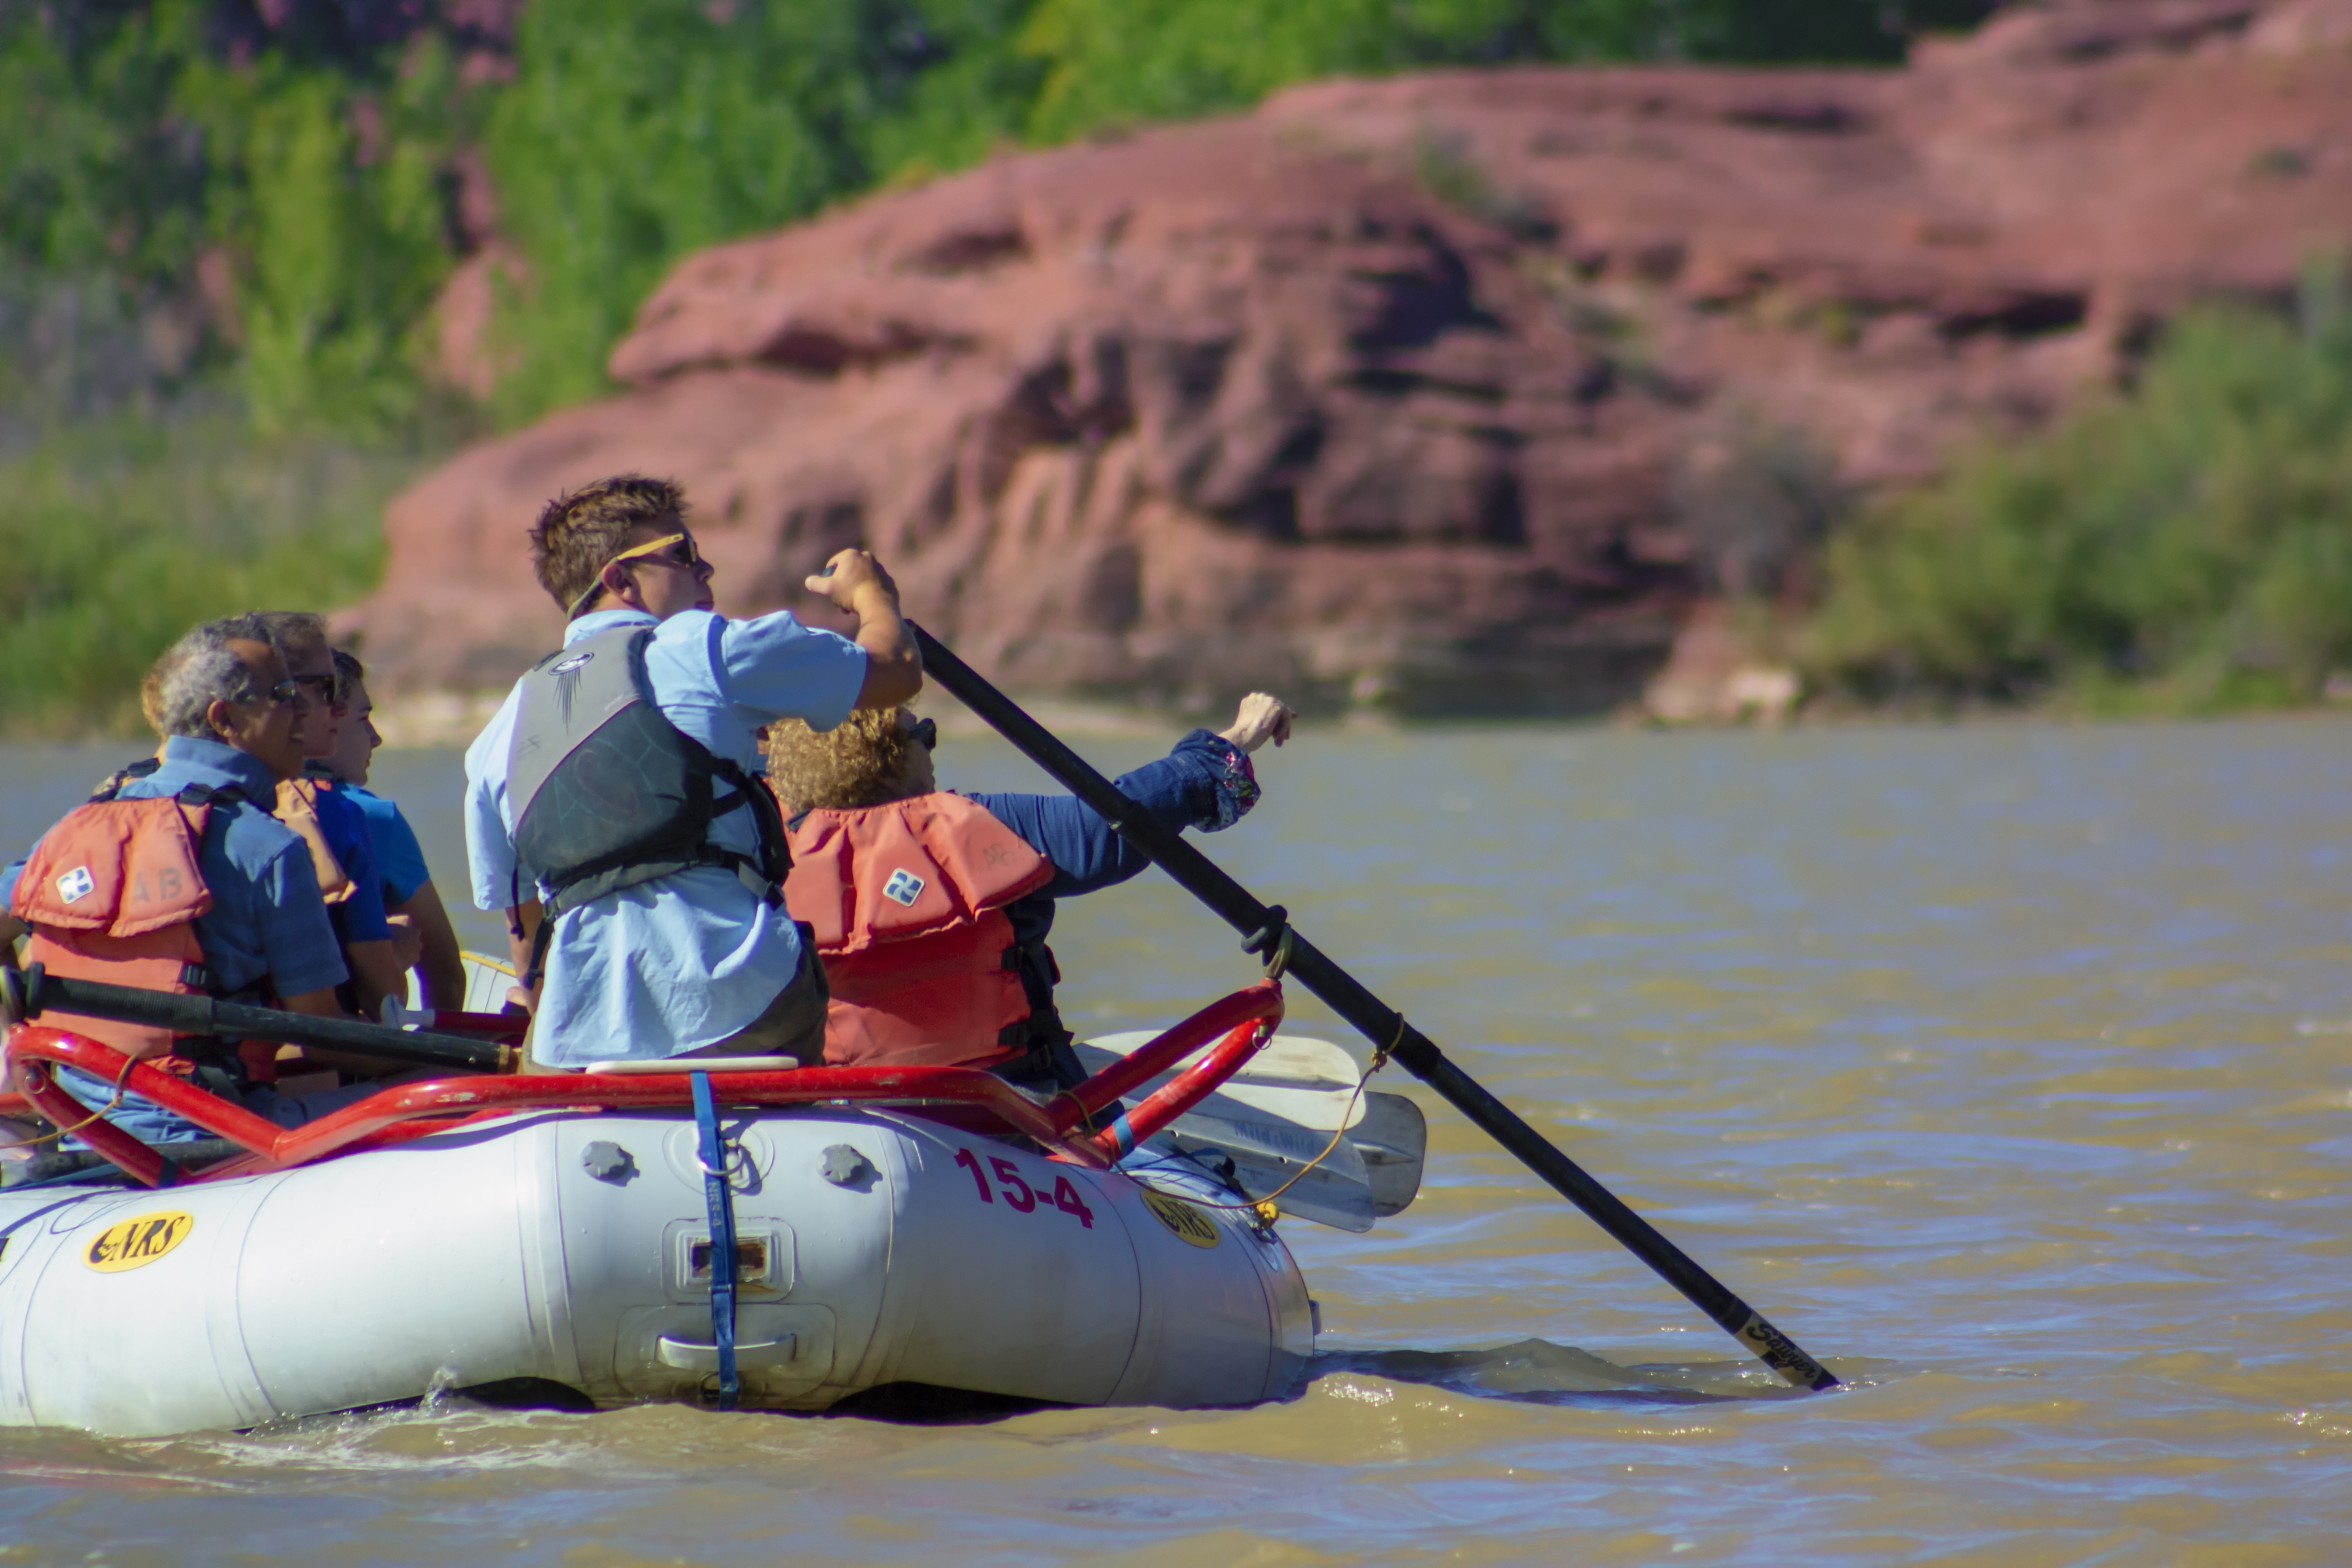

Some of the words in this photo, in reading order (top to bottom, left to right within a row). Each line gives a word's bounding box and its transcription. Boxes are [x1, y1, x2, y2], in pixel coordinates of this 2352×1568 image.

[953, 1148, 1094, 1230] 15-4
[107, 1216, 186, 1262] NRS
[1746, 1323, 1816, 1378] Sawyer
